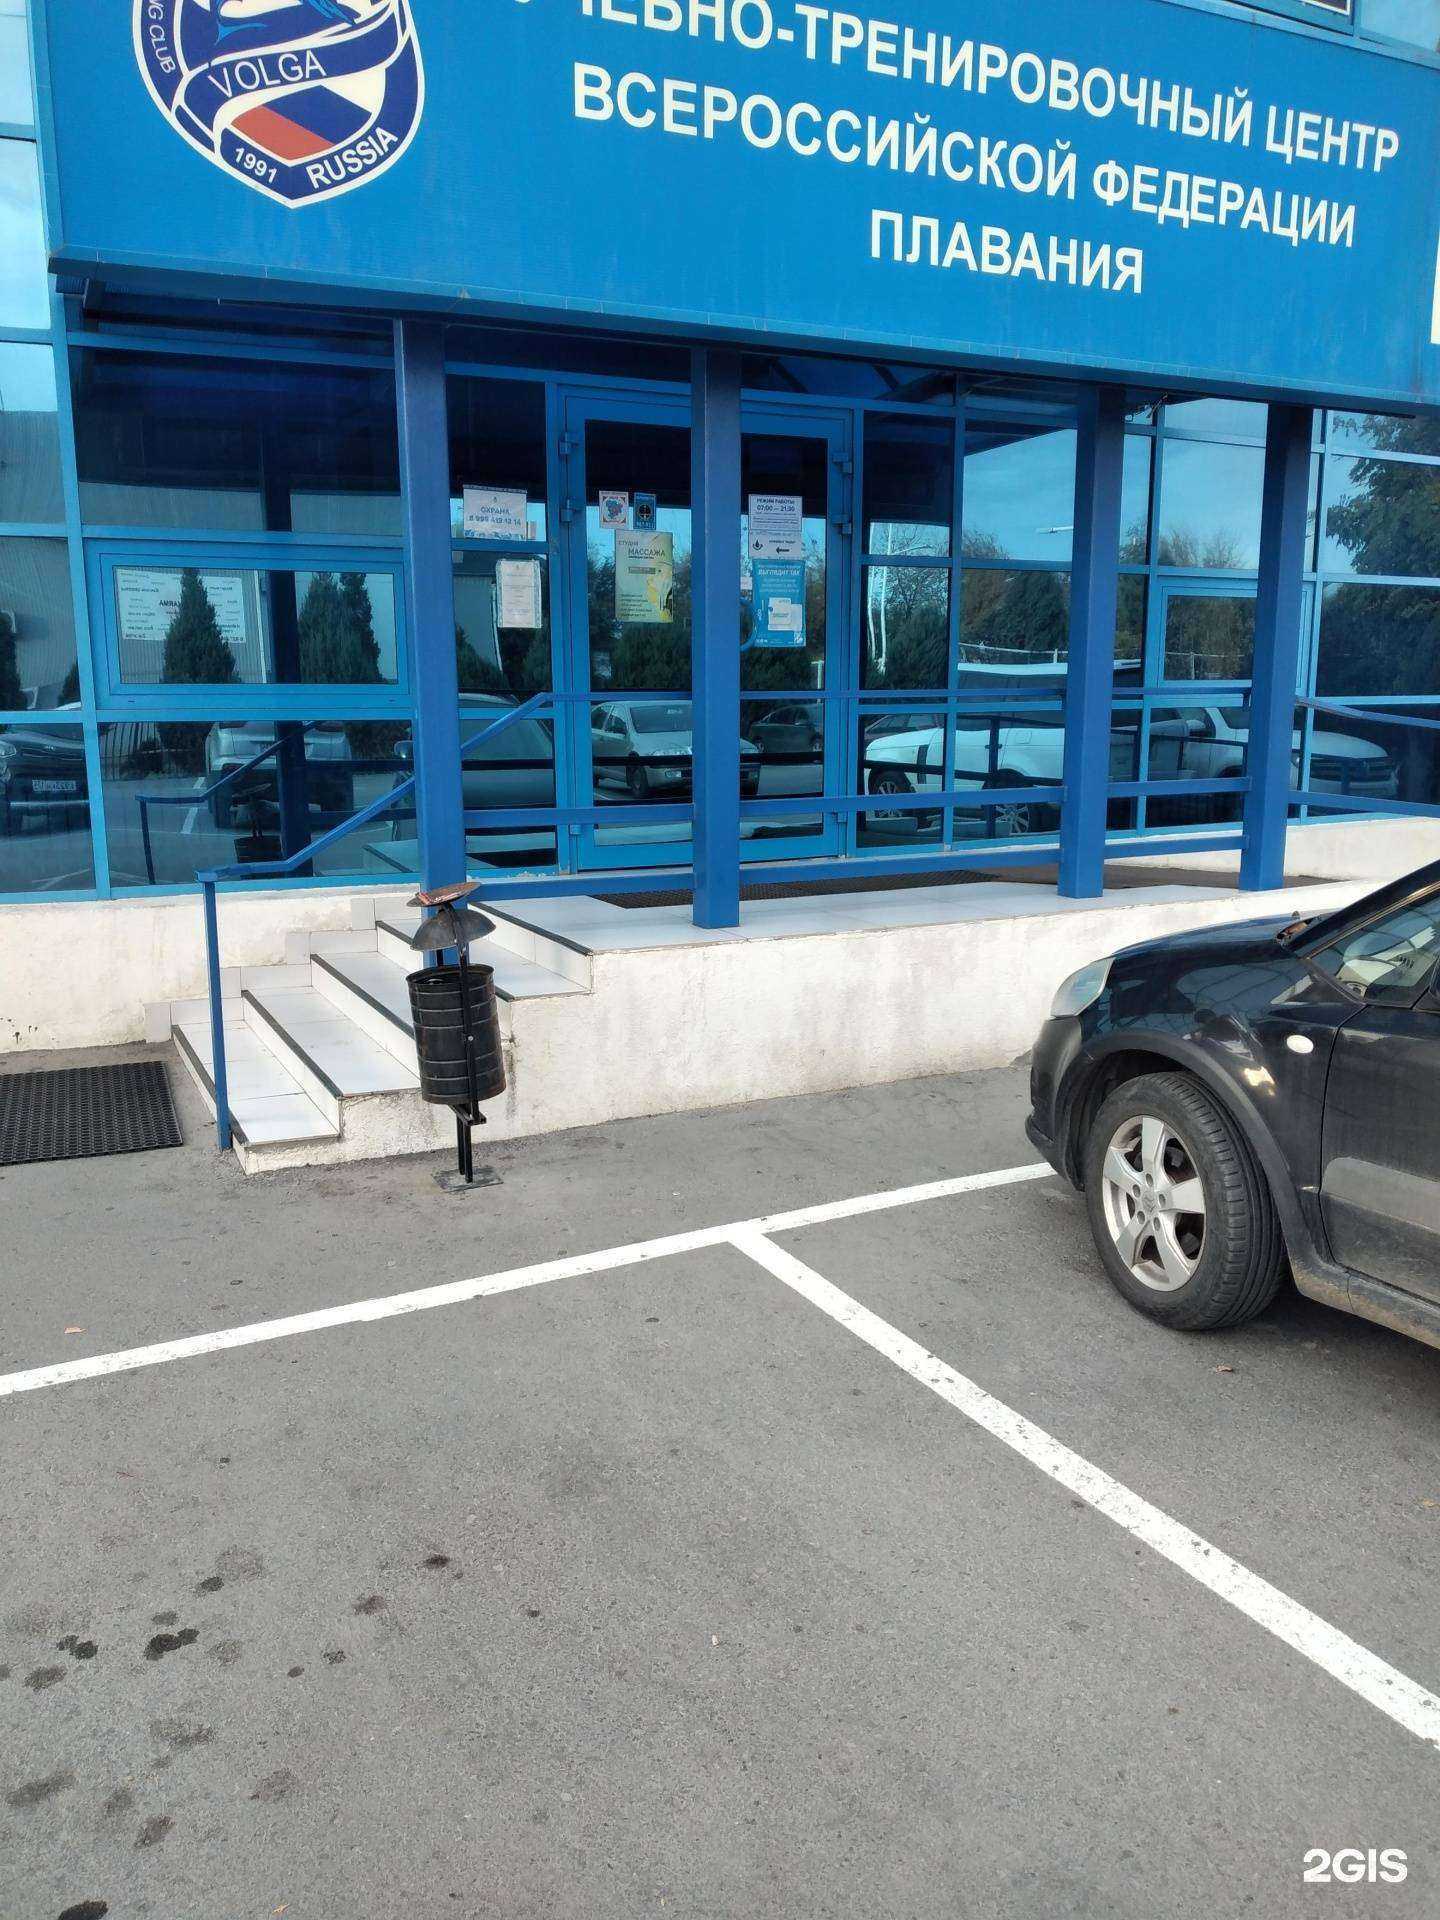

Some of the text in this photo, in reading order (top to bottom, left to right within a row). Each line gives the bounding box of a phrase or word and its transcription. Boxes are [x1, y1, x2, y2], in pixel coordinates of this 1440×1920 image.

[149, 24, 177, 74] CLUB
[207, 50, 327, 99] VOLGA
[305, 126, 399, 189] RUSSIA
[573, 61, 1356, 248] ВСЕРОССИЙСКОЙ ФЕДЕРАЦИИ
[1266, 104, 1400, 173] ЦЕНТР
[235, 147, 278, 184] 1991
[870, 209, 1144, 295] ПЛАВАНИЯ
[480, 506, 511, 516] ОХРАНА
[628, 547, 666, 556] МАССАЖА
